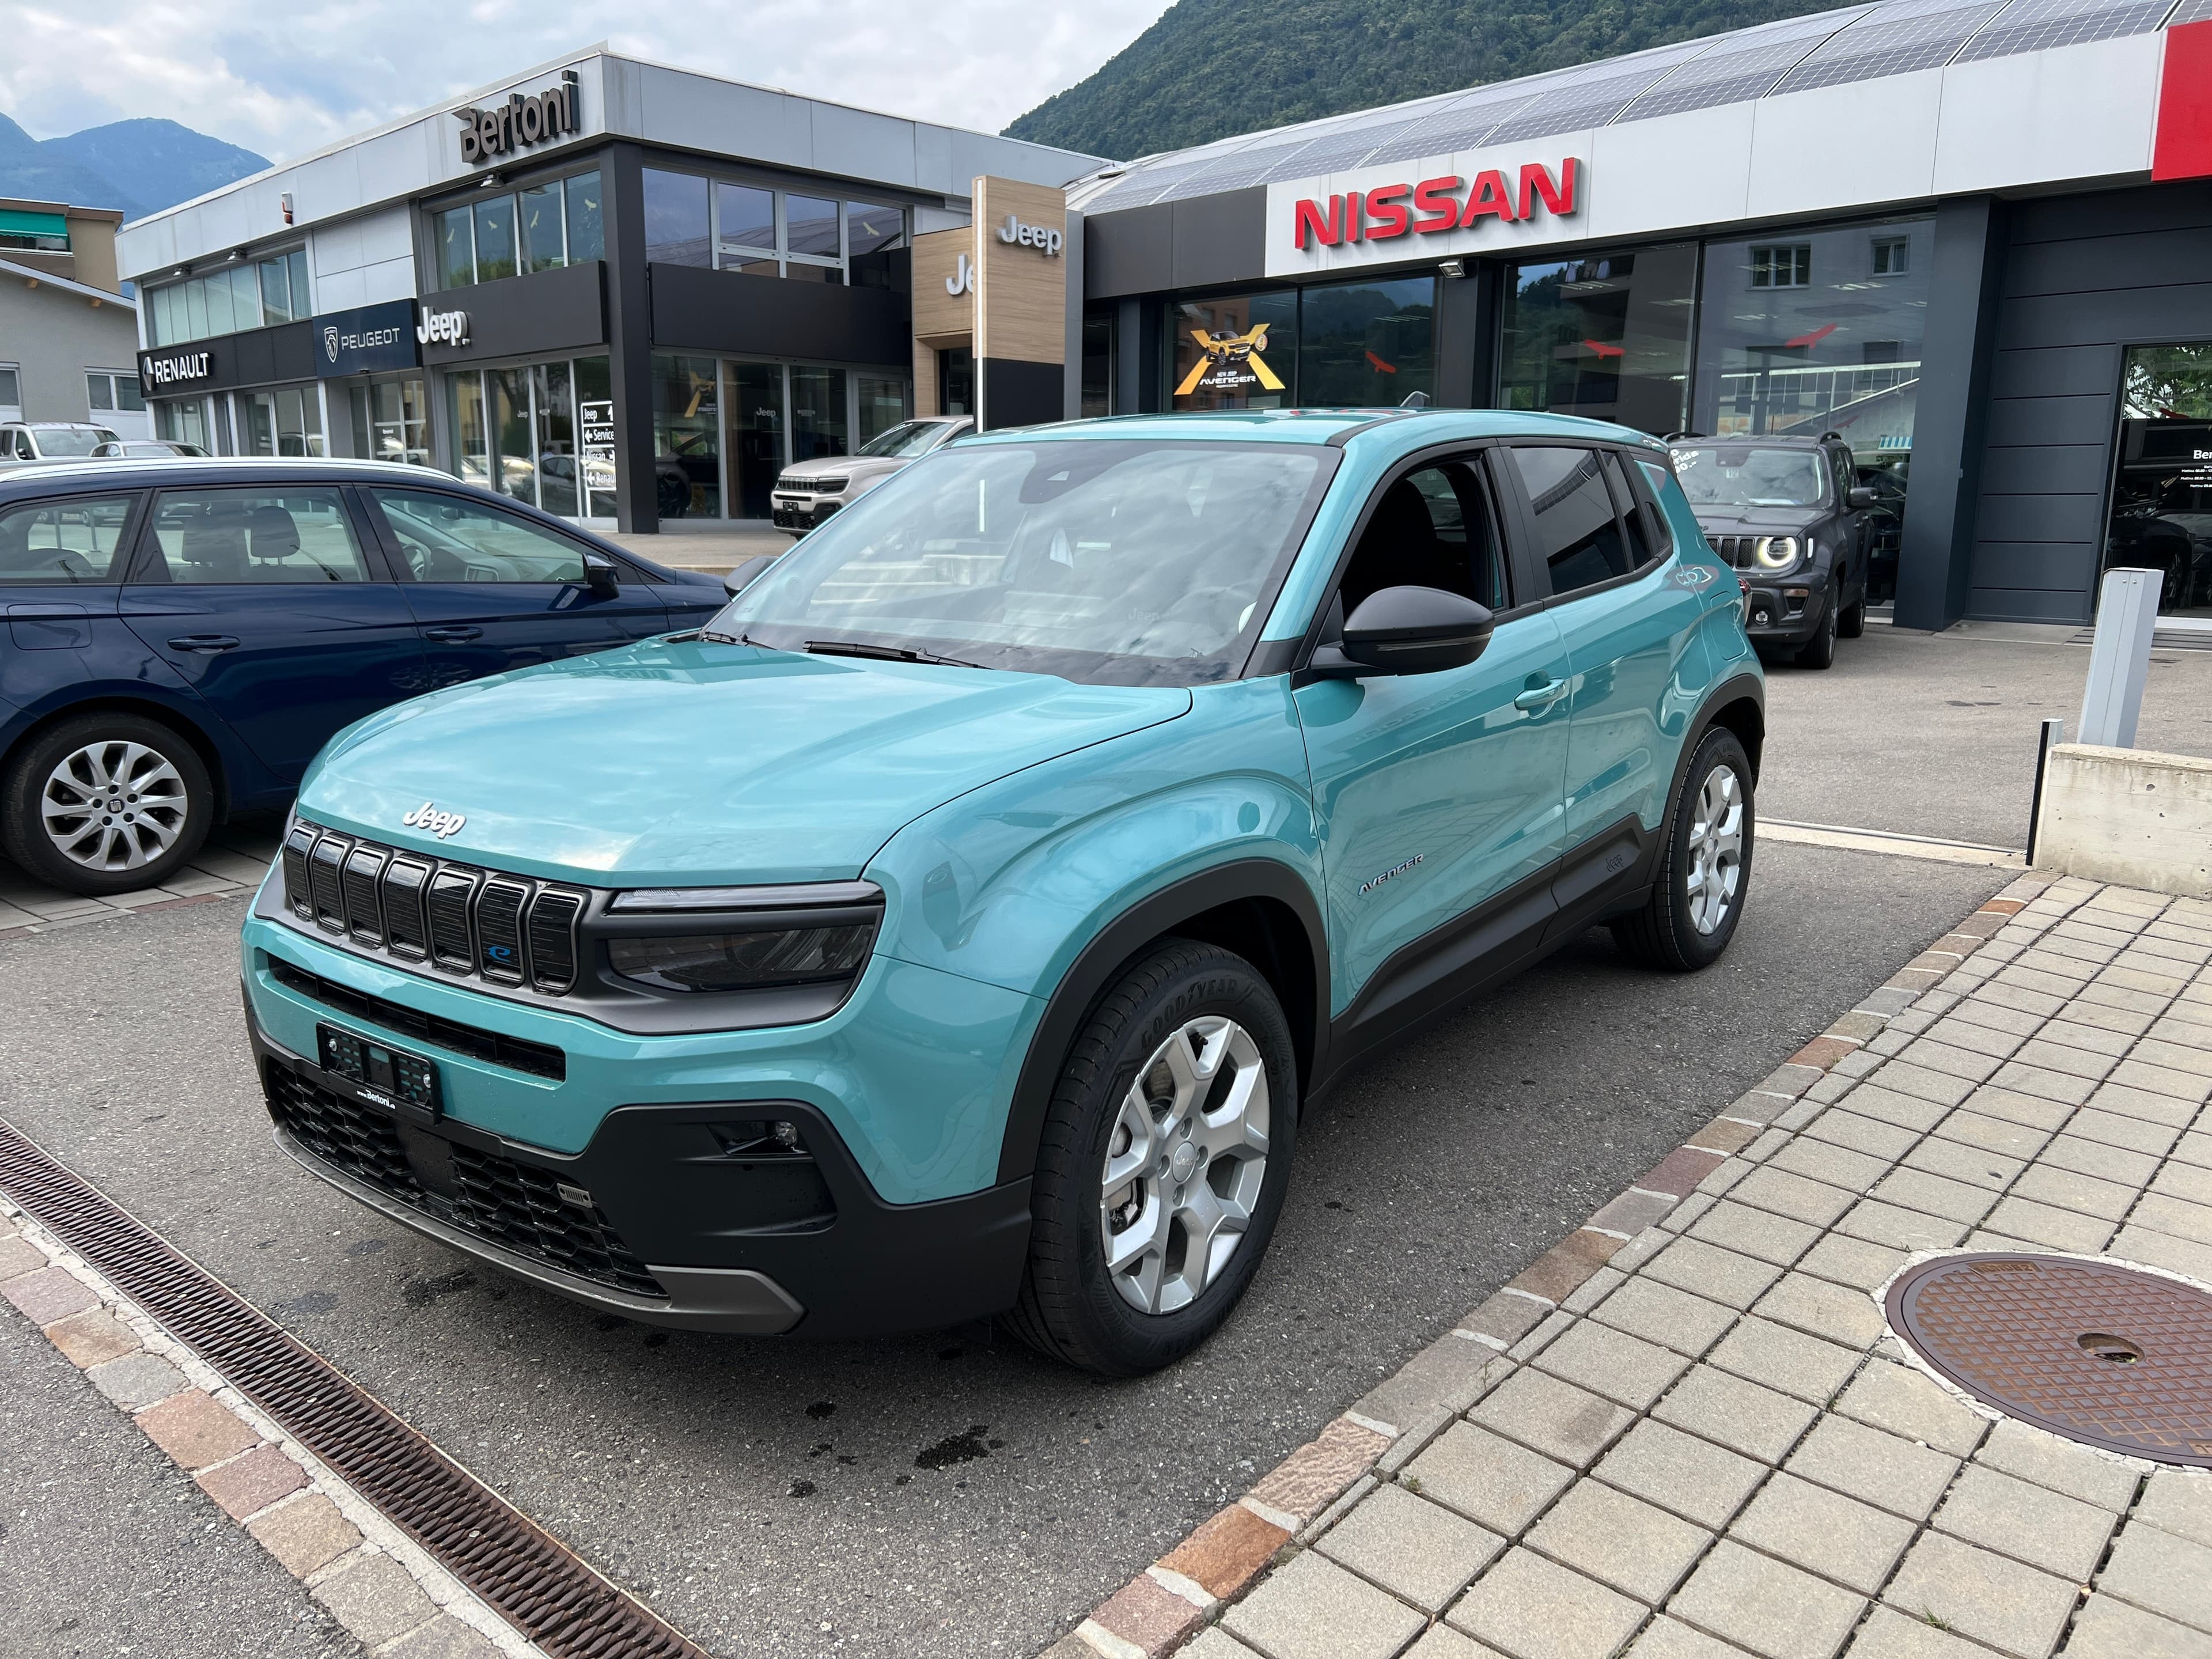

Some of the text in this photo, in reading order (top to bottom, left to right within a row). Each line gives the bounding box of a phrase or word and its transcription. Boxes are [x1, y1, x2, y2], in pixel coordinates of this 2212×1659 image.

[452, 70, 580, 164] Bertoni
[1295, 157, 1581, 250] NISSAN
[995, 214, 1062, 257] Jeep
[341, 327, 400, 350] PEUGEOT
[416, 306, 468, 346] Jeep
[154, 352, 209, 384] RENAULT
[1199, 376, 1256, 385] AVENGER
[584, 408, 597, 422] Jeep
[756, 407, 777, 418] Jeep
[593, 428, 615, 441] Service
[403, 801, 467, 839] Jeep
[1358, 853, 1423, 896] AVENGER
[1605, 854, 1623, 872] Jeep
[1141, 978, 1239, 1050] GOODYEAR
[1176, 1154, 1194, 1168] Jeep
